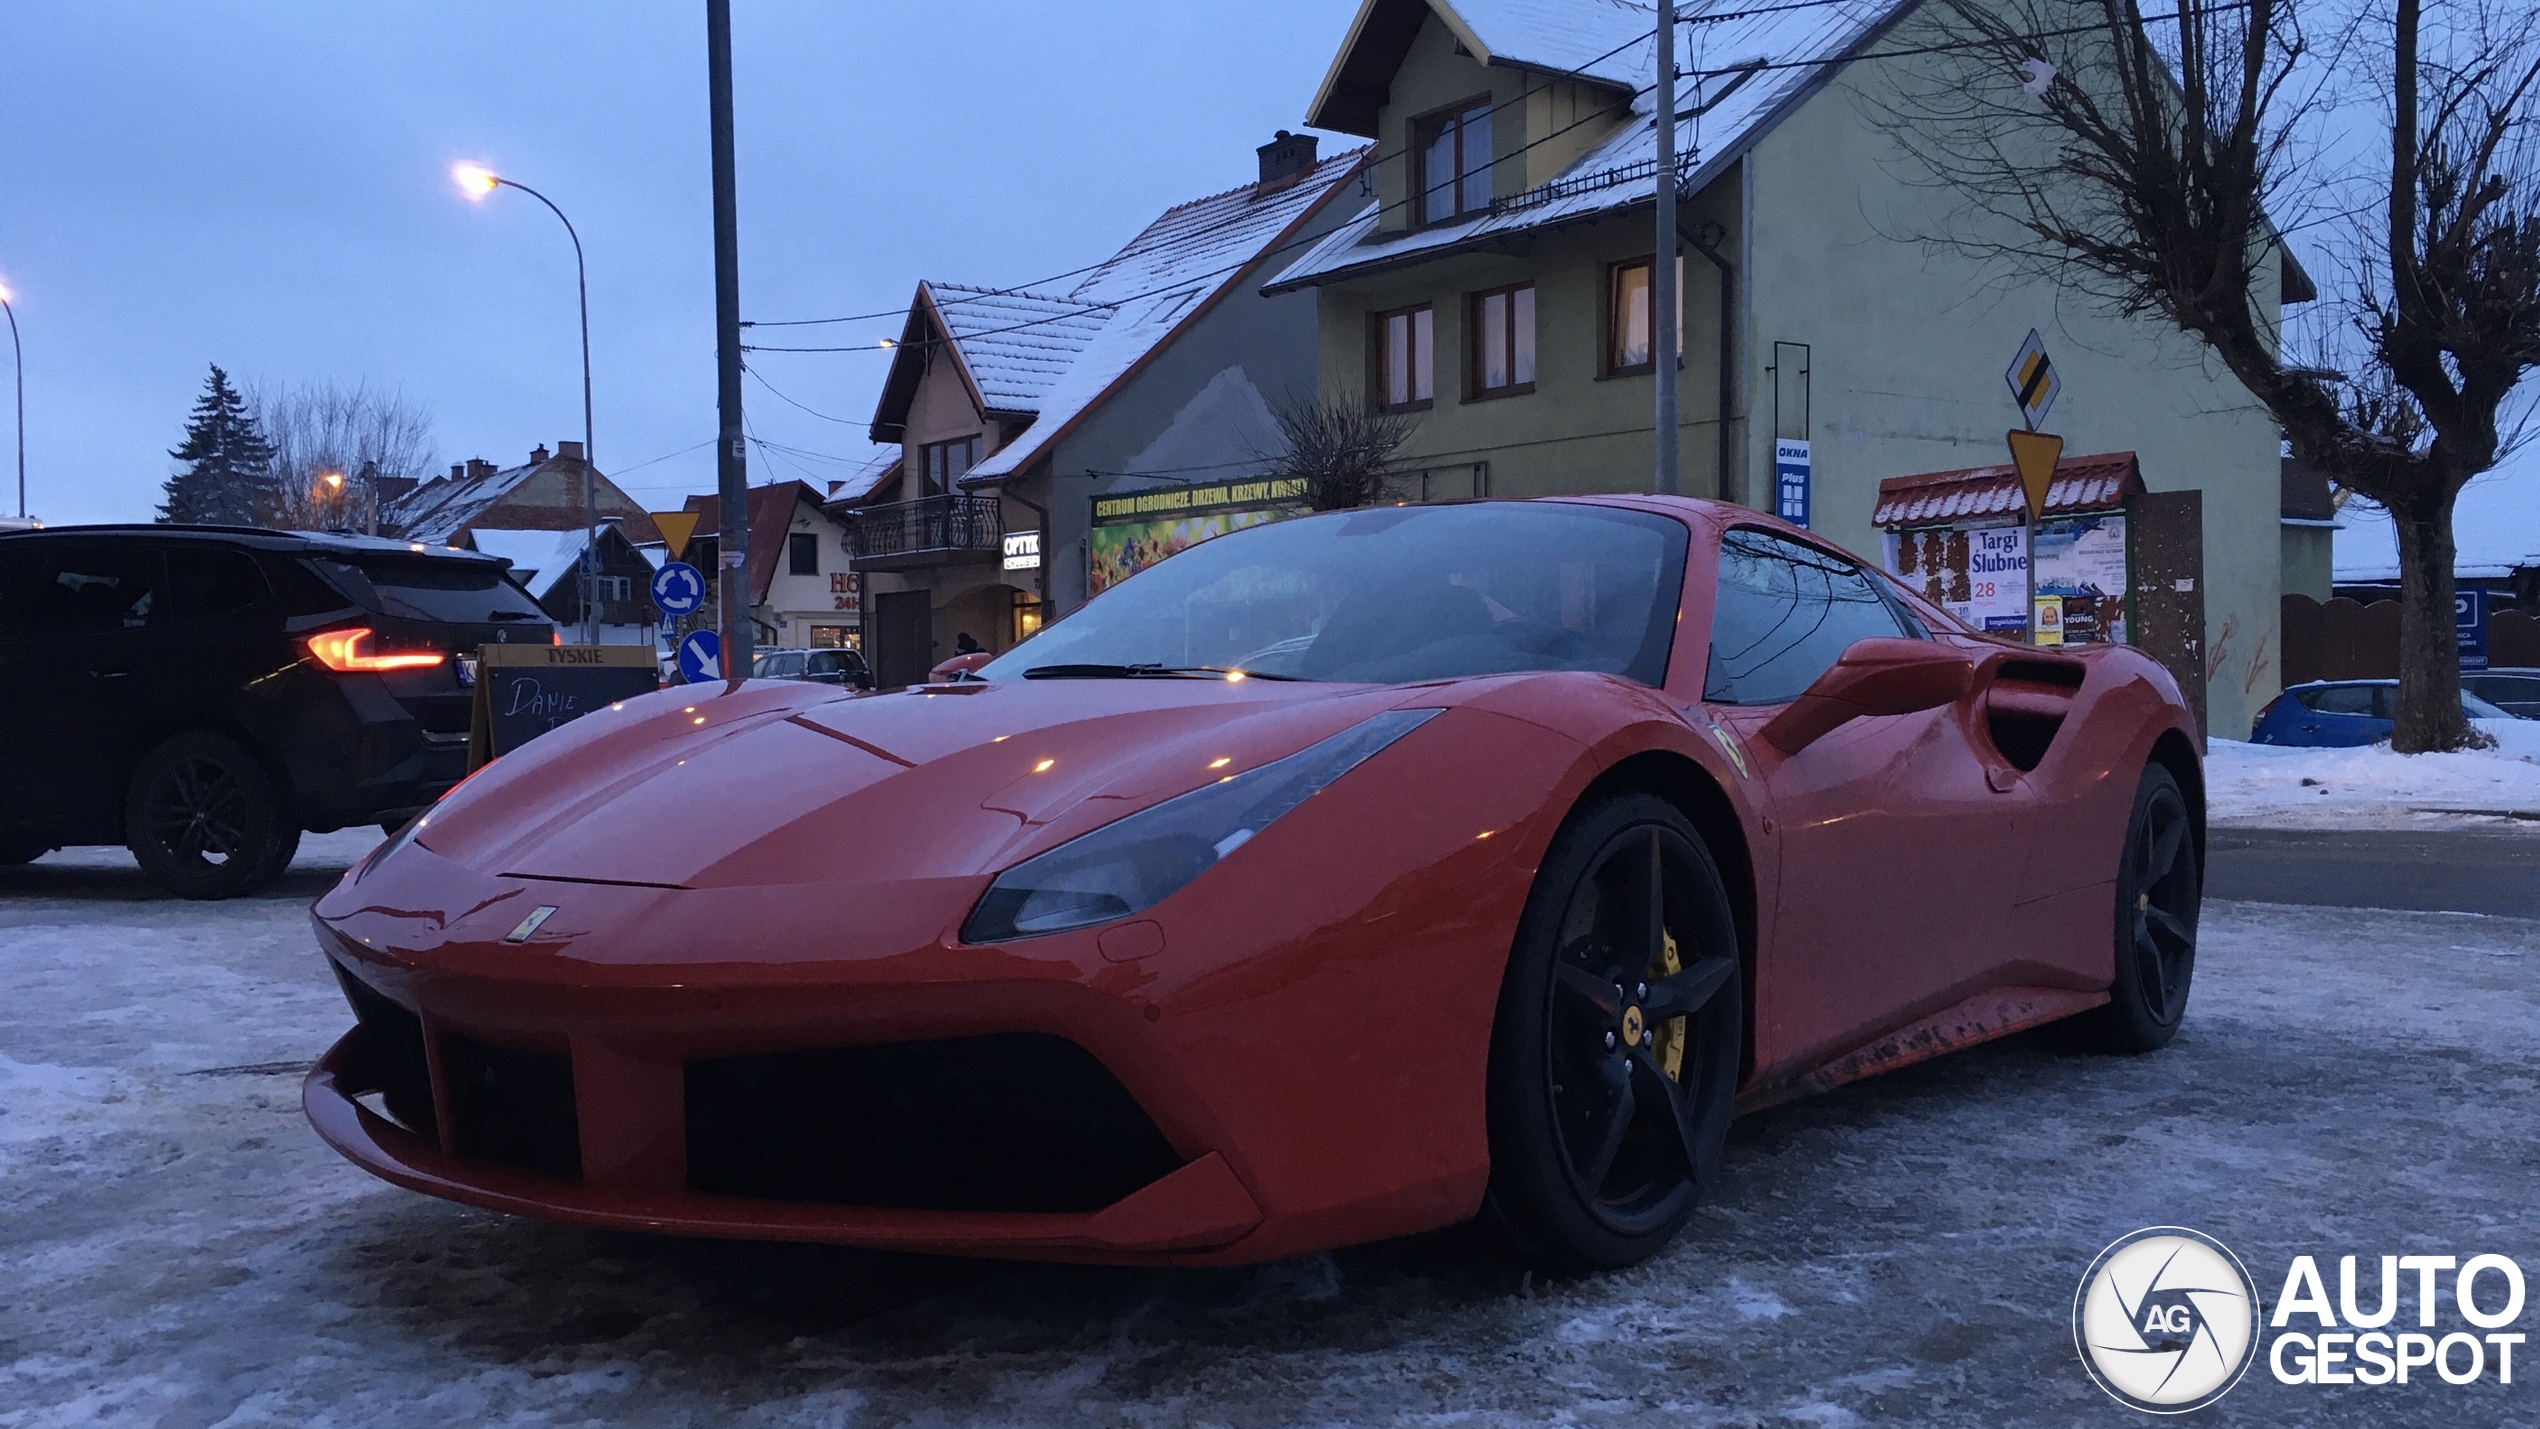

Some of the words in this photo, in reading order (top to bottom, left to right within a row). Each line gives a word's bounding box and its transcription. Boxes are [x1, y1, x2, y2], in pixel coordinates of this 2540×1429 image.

[1779, 448, 1807, 458] OKNA
[1782, 473, 1804, 483] Plus
[1096, 498, 1135, 517] CENTRUM
[1192, 486, 1231, 507] DRZEWA,
[1231, 481, 1270, 502] KRZEWY,
[1004, 535, 1039, 556] OPTYK
[1979, 530, 2018, 554] Targi
[1972, 549, 2027, 573] Ślubne
[1975, 582, 1995, 597] 28
[2064, 615, 2094, 624] YOUNG
[548, 649, 603, 664] TYSKIE
